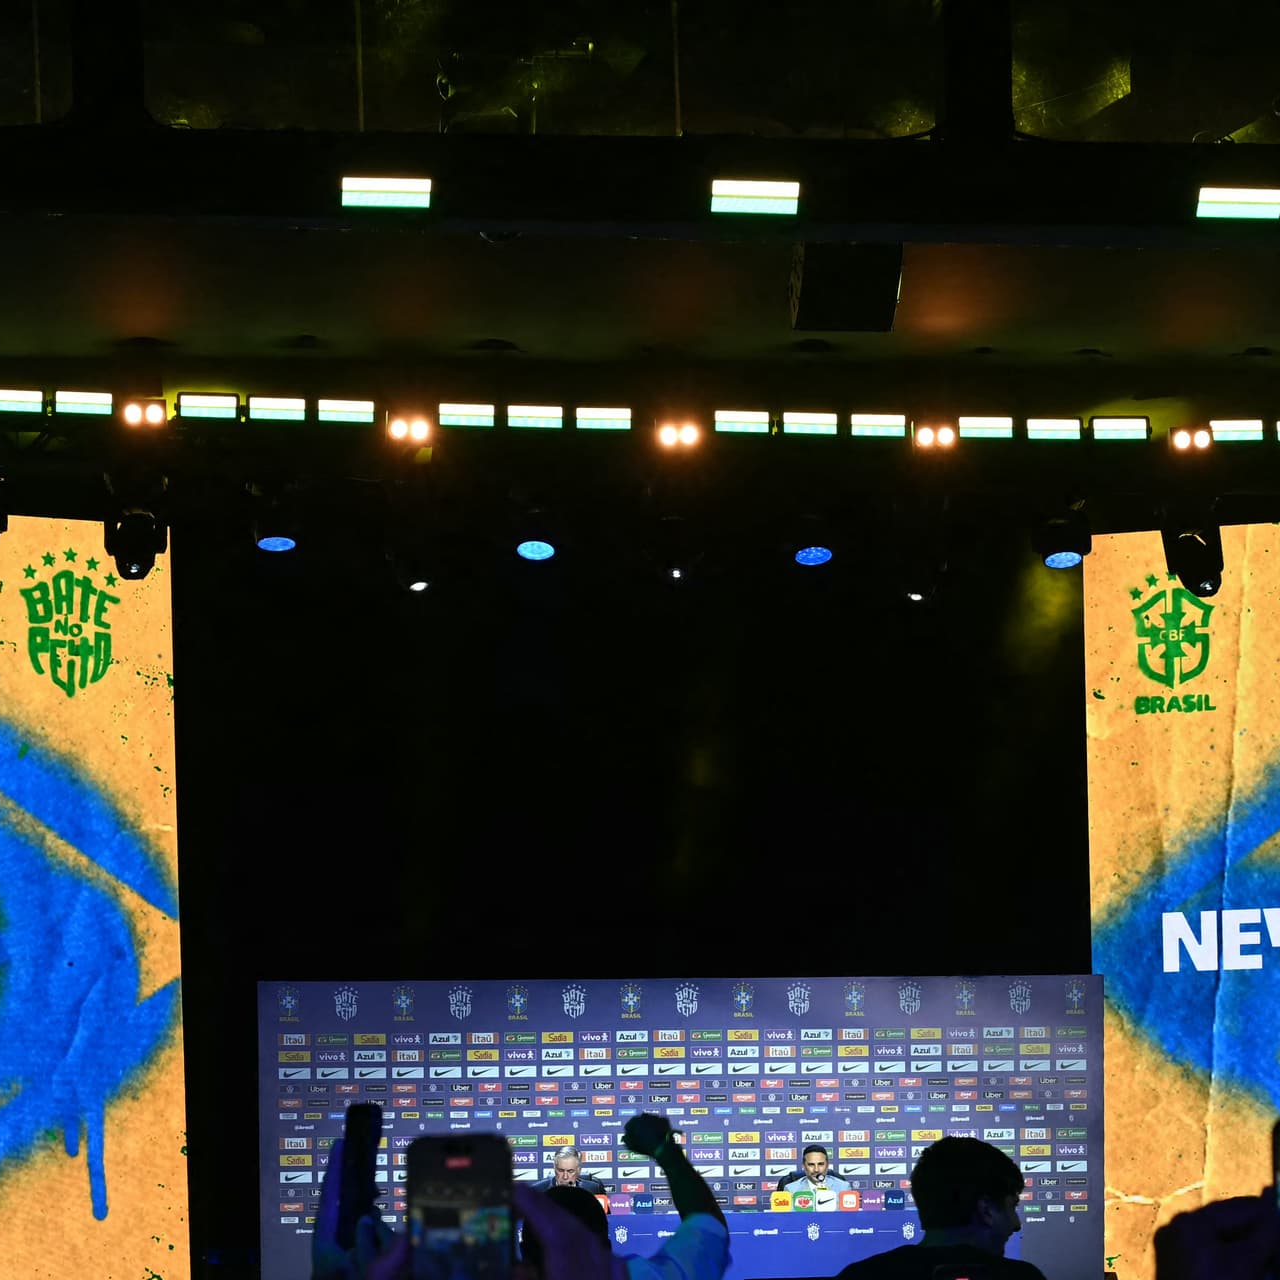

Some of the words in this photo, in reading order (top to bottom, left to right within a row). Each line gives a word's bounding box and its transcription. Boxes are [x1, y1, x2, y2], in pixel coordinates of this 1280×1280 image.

[19, 570, 121, 629] BATE
[55, 615, 83, 637] NO
[28, 627, 111, 698] PEITO
[1134, 694, 1216, 714] BRASIL
[619, 1033, 637, 1041] Azul
[660, 1031, 678, 1040] itaú
[734, 1031, 753, 1039] Sadia
[767, 1031, 786, 1039] vivo
[844, 1030, 862, 1038] itaú
[950, 1029, 968, 1037] vivo
[474, 1033, 491, 1042] itaú
[548, 1034, 567, 1042] Sadia
[730, 1048, 748, 1056] Azul
[772, 1047, 789, 1056] itaú
[877, 1047, 896, 1055] vivo
[1058, 1044, 1077, 1052] vivo
[357, 1052, 375, 1060] Azul
[399, 1051, 416, 1060] itaú
[507, 1051, 527, 1059] vivo
[544, 1051, 562, 1059] Azul
[587, 1049, 603, 1058] itaú
[452, 1084, 469, 1092] Uber
[735, 1133, 753, 1142] Sadia
[1026, 1129, 1044, 1138] itaú
[549, 1136, 568, 1145] Sadia
[582, 1136, 602, 1144] vivo
[1059, 1146, 1077, 1154] vivo
[636, 1200, 653, 1208] Azul
